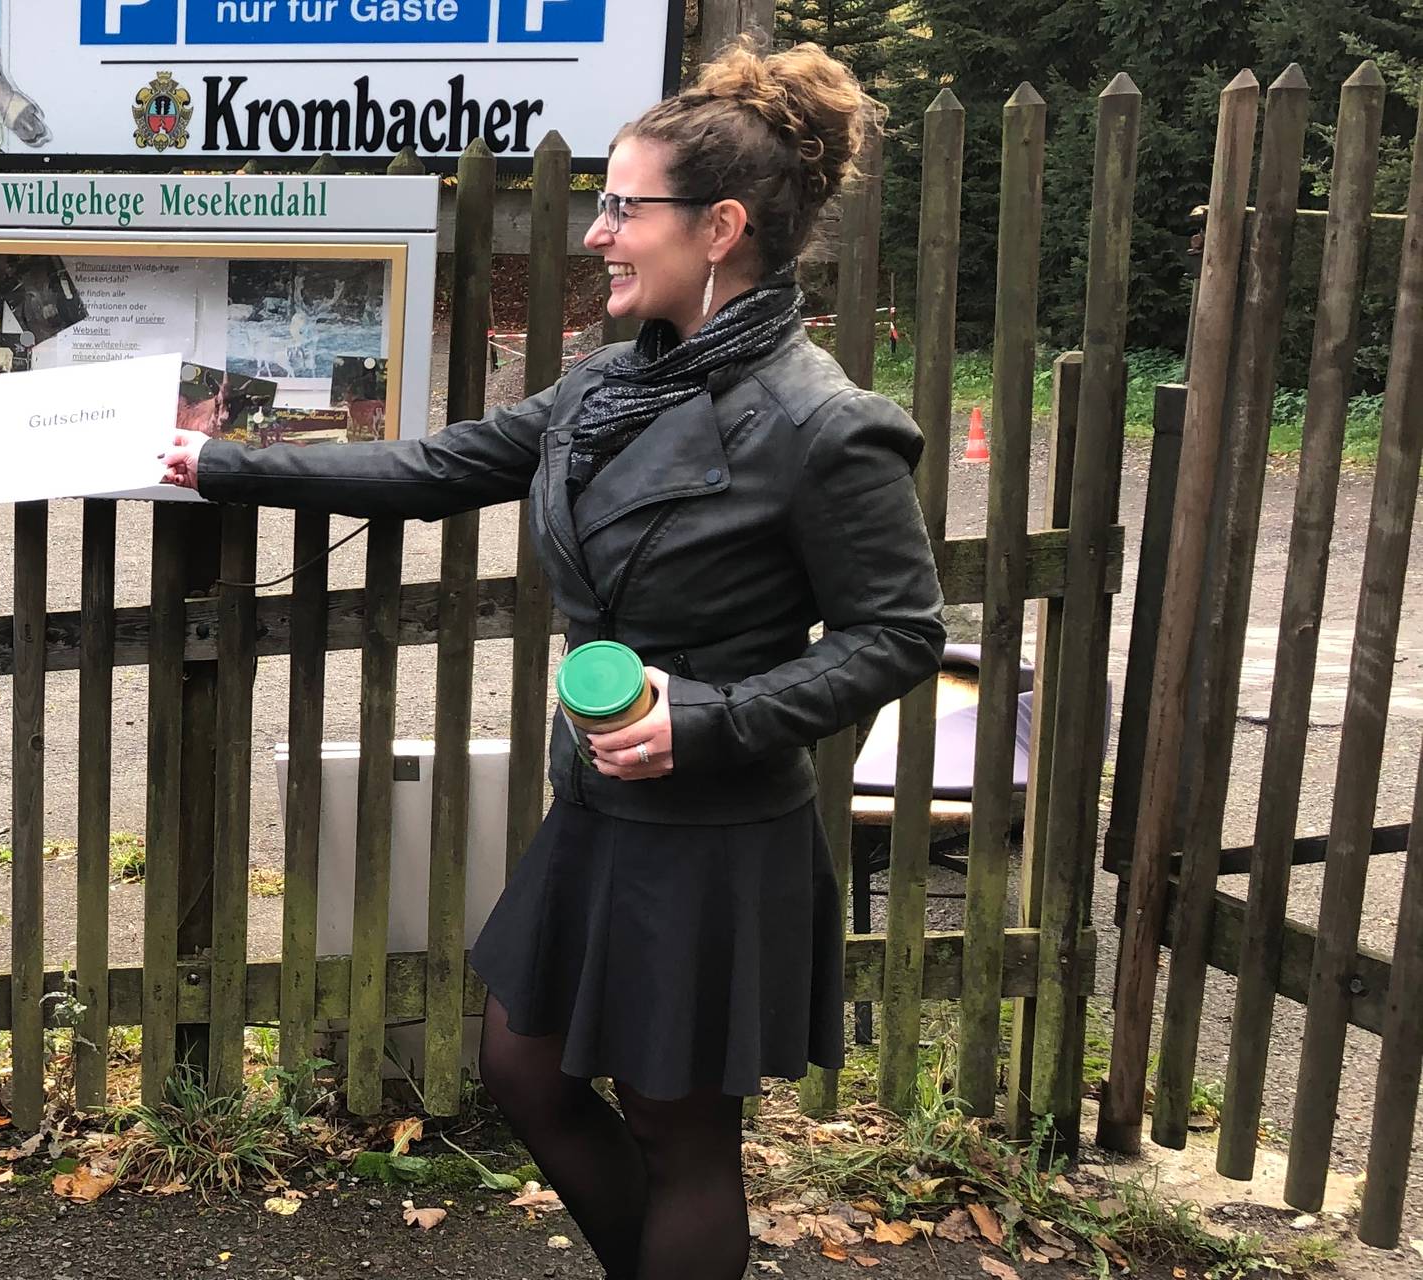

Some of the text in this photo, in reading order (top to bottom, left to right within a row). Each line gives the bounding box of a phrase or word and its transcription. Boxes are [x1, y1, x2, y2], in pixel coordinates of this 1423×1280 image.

[216, 0, 276, 22] nur
[202, 74, 544, 153] Krombacher
[1, 180, 328, 226] Wildgehege Mesekendahl
[129, 302, 148, 310] oder
[121, 315, 134, 323] auf
[135, 316, 166, 324] unserer
[28, 404, 116, 428] Gutschein
